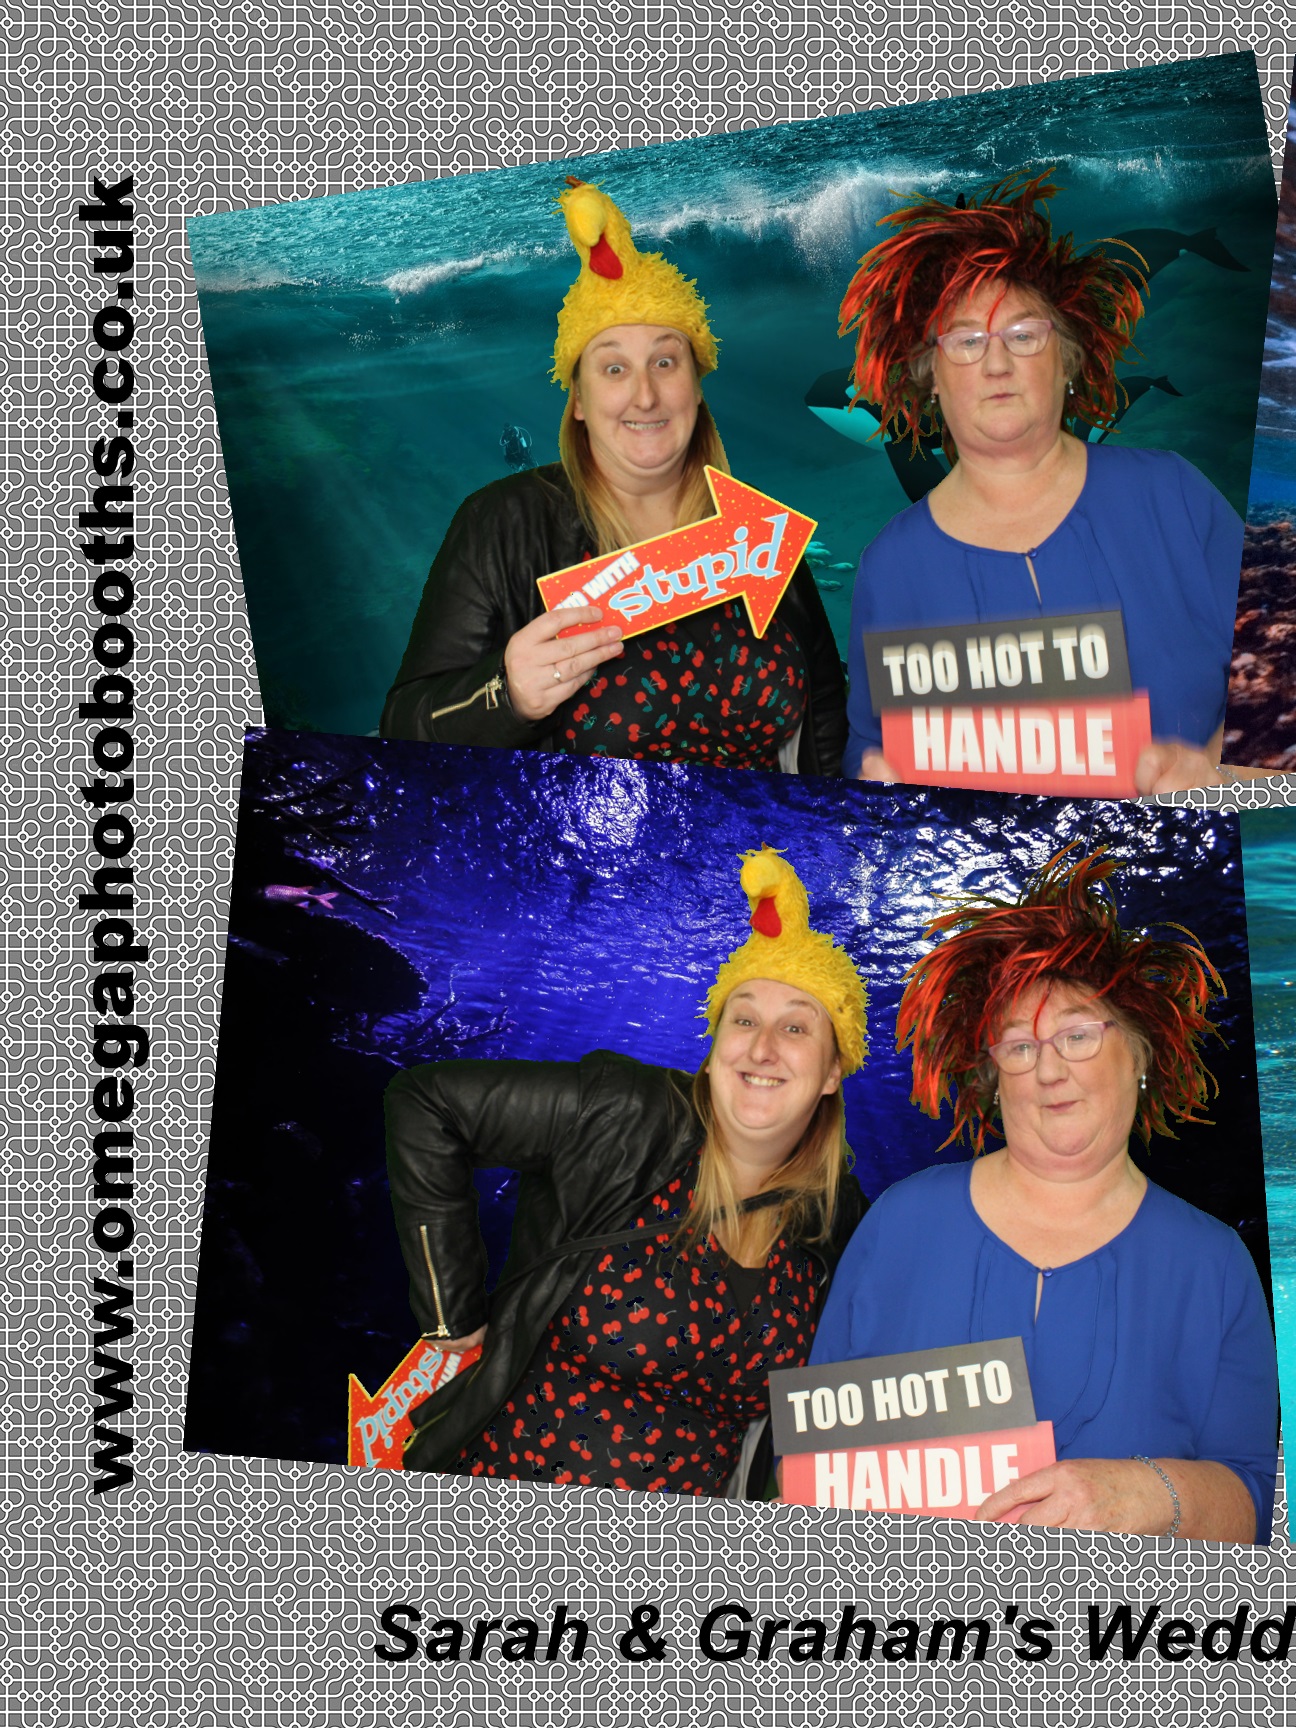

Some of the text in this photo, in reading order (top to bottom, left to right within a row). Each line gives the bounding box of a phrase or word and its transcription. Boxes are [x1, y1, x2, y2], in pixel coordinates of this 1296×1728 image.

[582, 550, 641, 600] WITH
[608, 512, 789, 622] stupid
[882, 623, 1110, 697] TOO HOT TO
[911, 706, 1117, 777] HANDLE
[355, 1346, 444, 1468] stupid
[787, 1360, 1013, 1433] TOO HOT TO
[814, 1444, 1020, 1510] HANDLE
